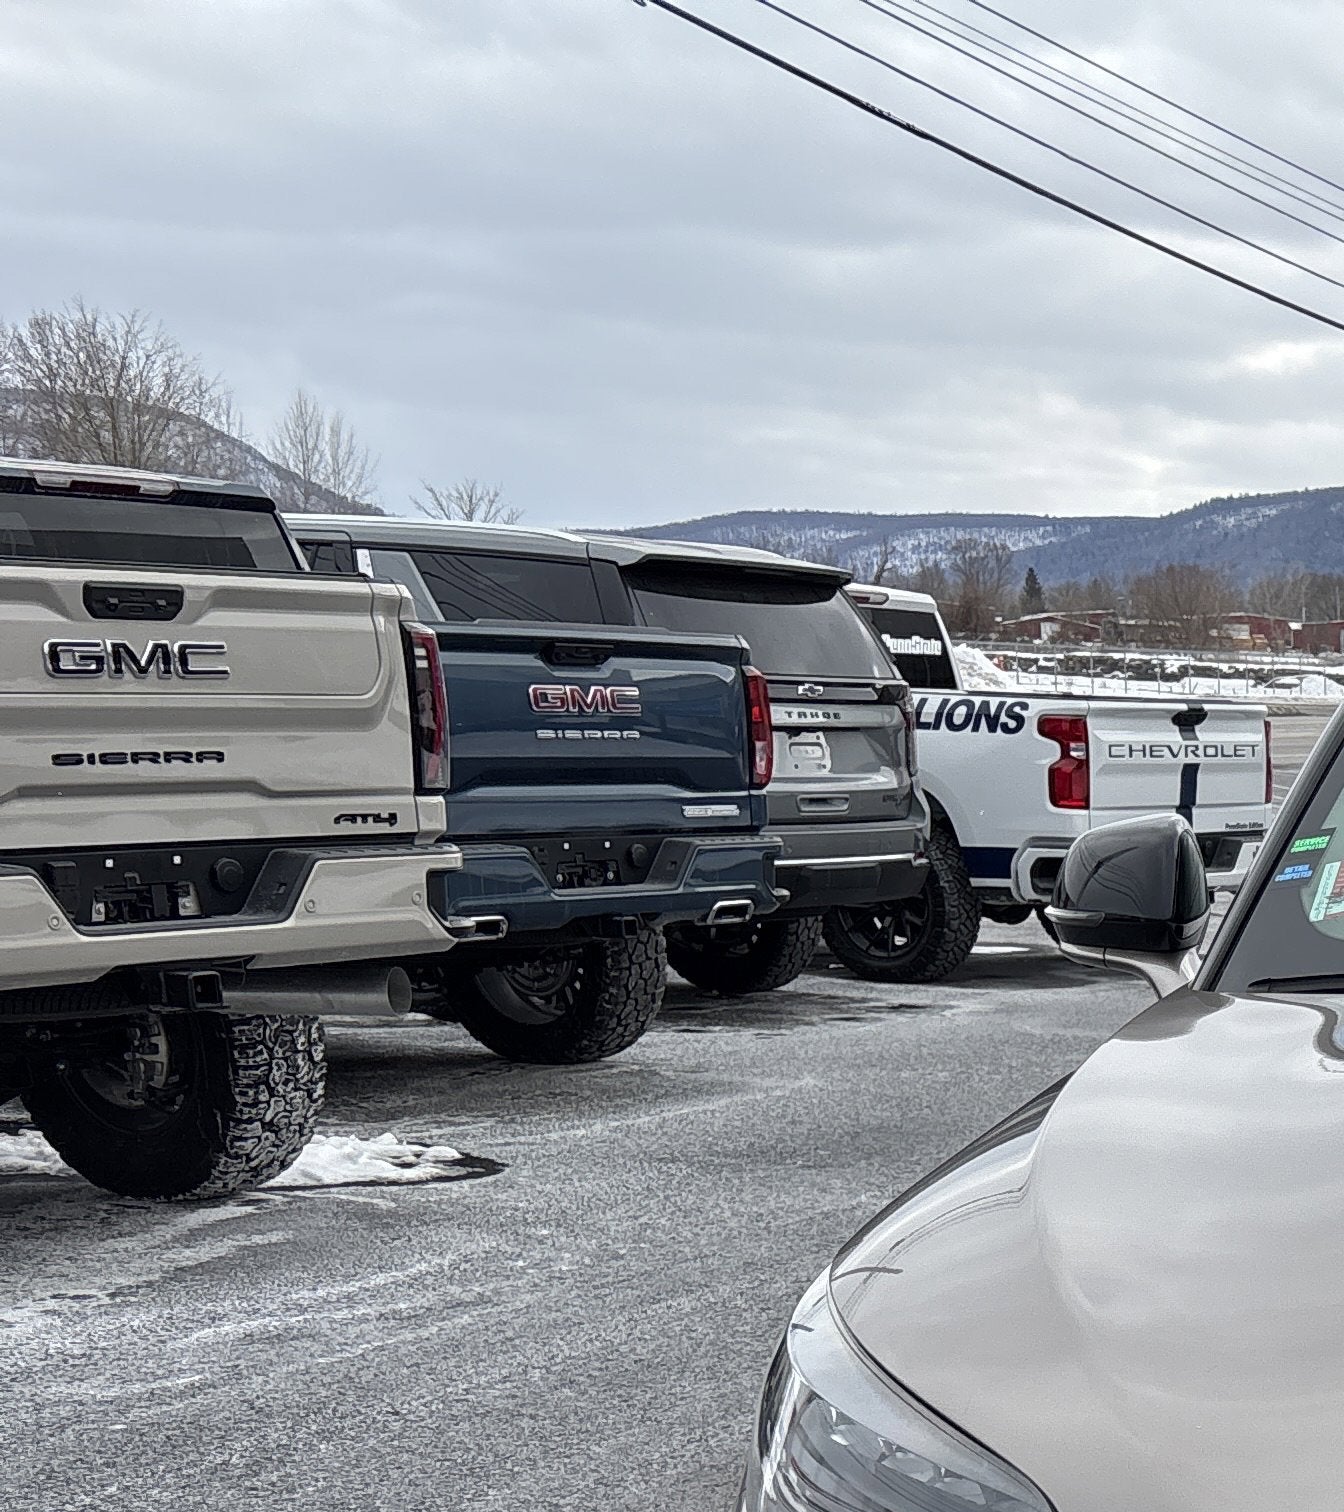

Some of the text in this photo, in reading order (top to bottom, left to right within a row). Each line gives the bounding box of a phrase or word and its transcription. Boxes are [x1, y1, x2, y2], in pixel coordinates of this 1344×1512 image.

[43, 638, 231, 679] GMC
[528, 684, 642, 716] GMC
[784, 709, 841, 720] TAHOE
[915, 697, 1030, 735] LIONS
[535, 729, 641, 740] SIERRA
[51, 750, 225, 766] SIERRA
[1108, 743, 1259, 759] CHEVROLET
[333, 812, 398, 828] AT4
